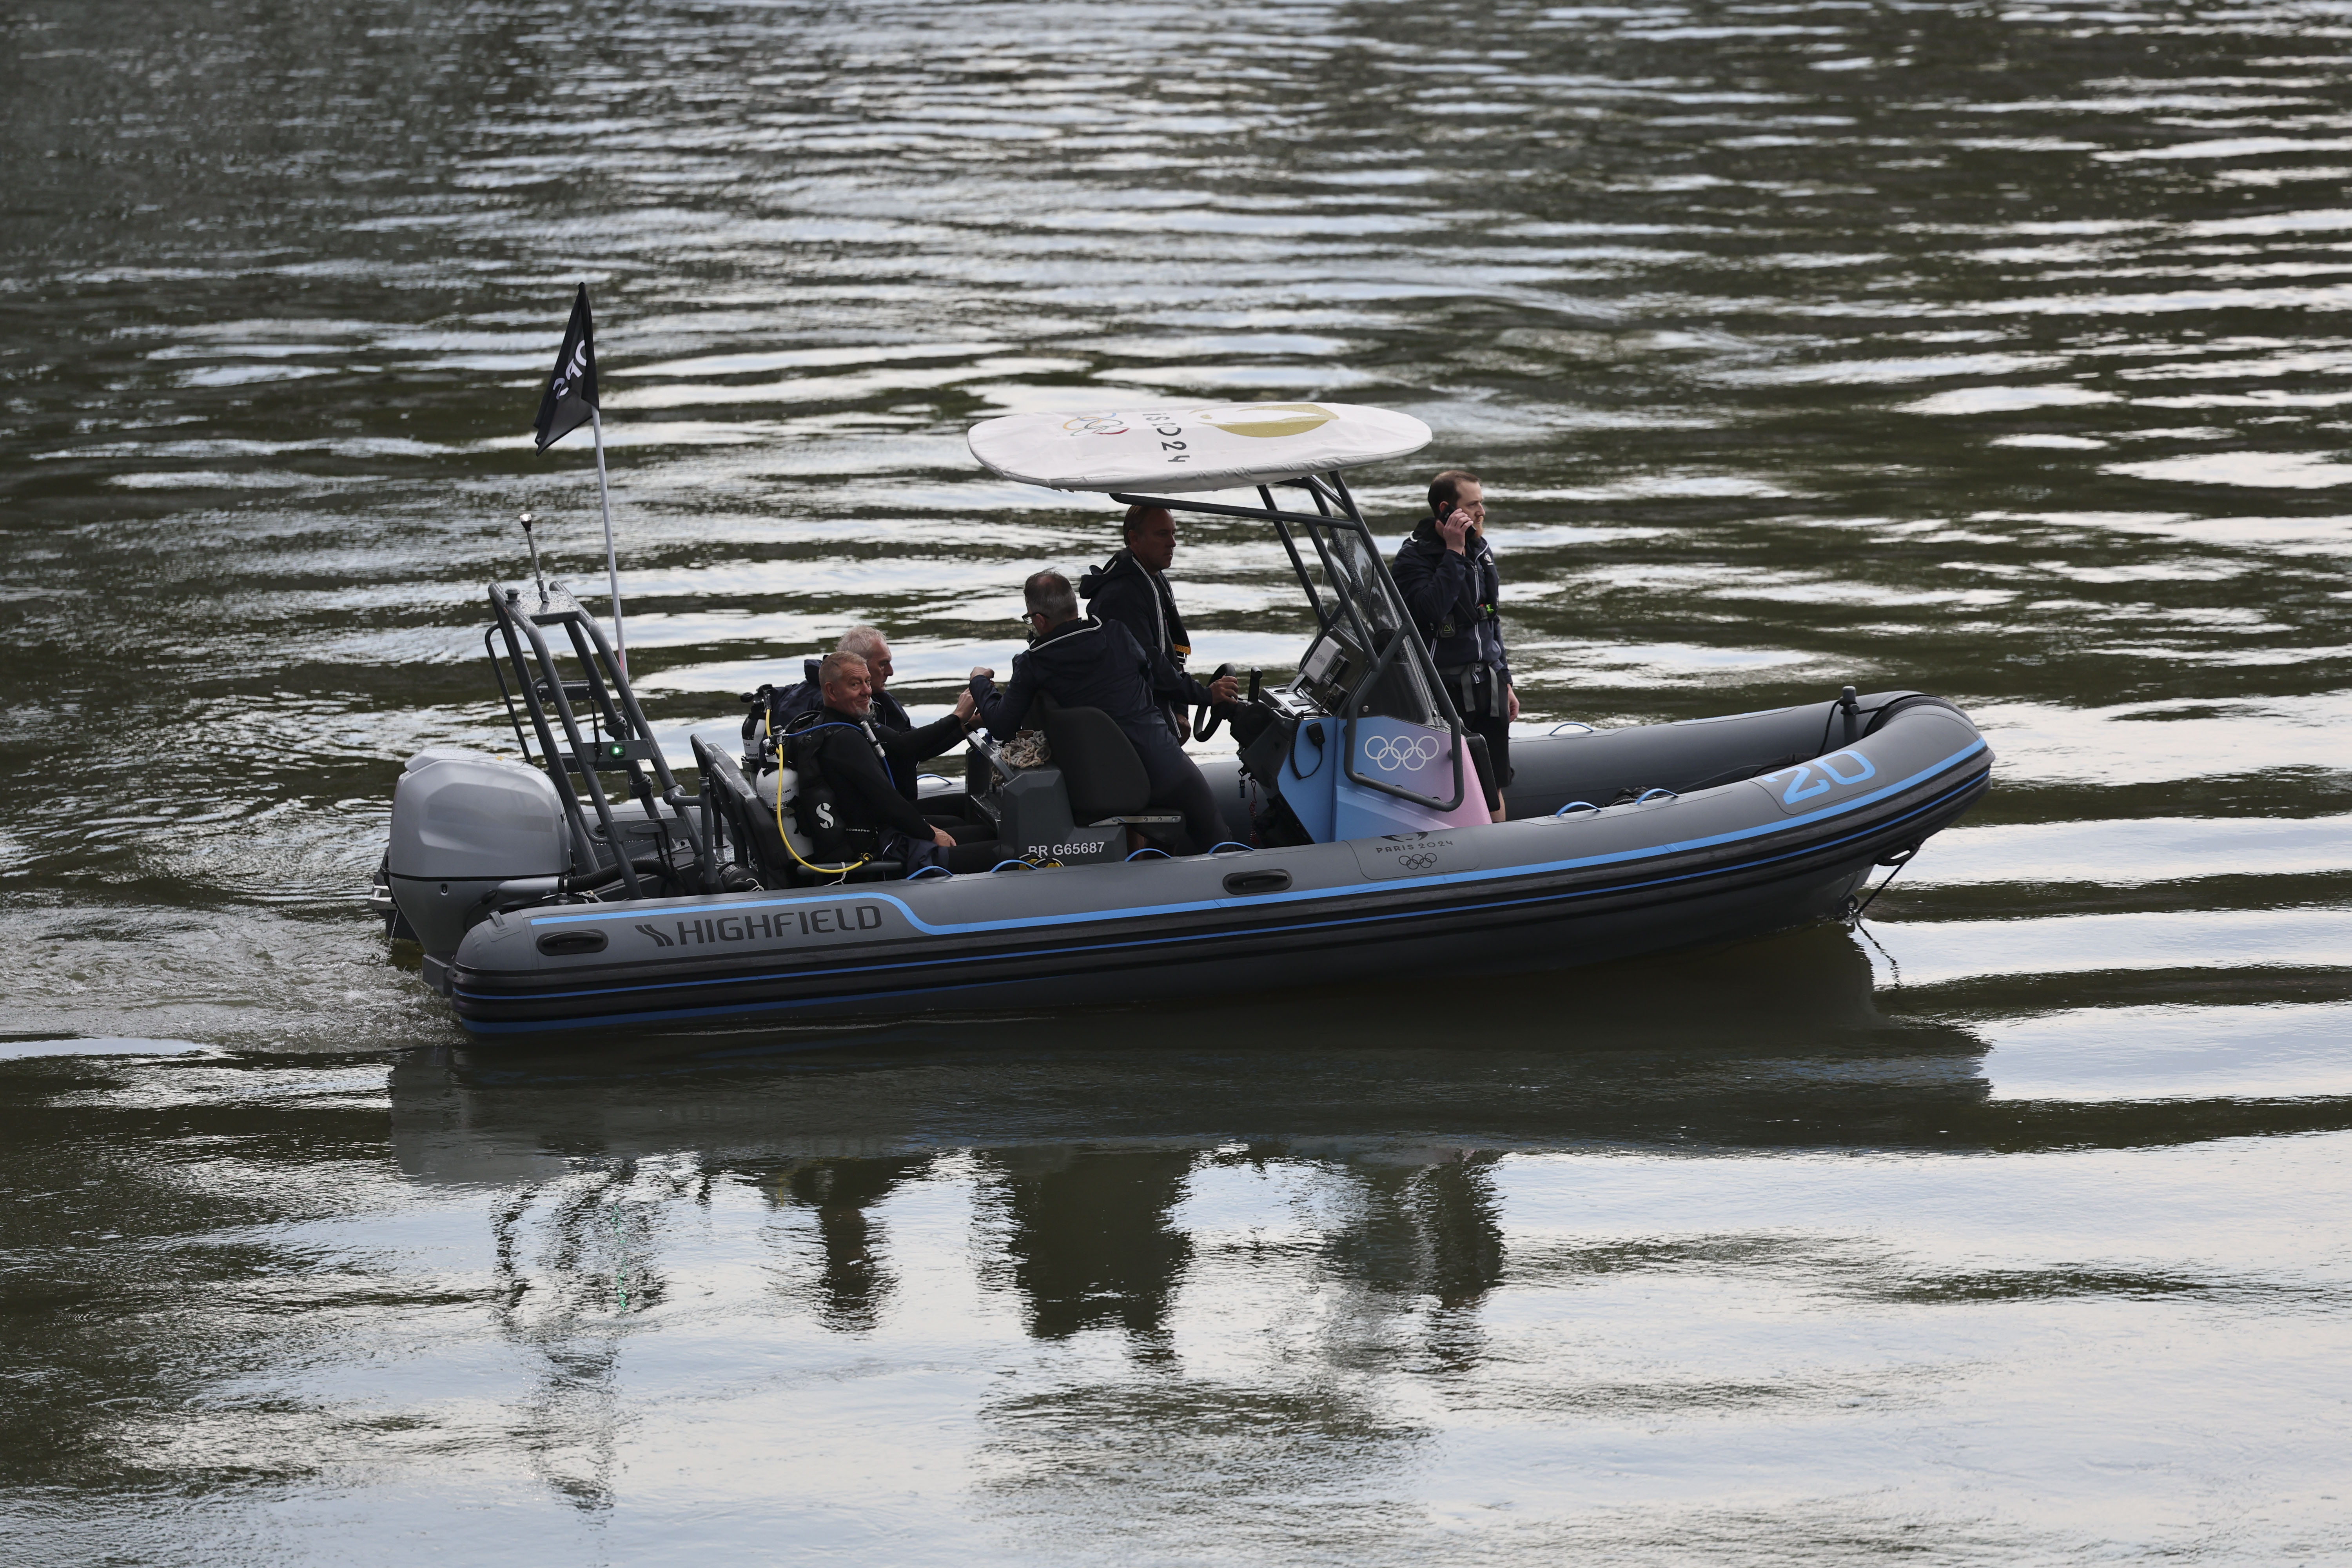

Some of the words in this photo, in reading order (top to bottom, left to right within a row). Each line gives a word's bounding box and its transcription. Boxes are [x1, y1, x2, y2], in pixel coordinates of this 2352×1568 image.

[1762, 750, 1876, 804] 20
[1053, 842, 1105, 855] G65687
[1376, 844, 1414, 853] PARIS
[1418, 840, 1453, 849] 2024
[677, 906, 882, 945] HIGHFIELD
